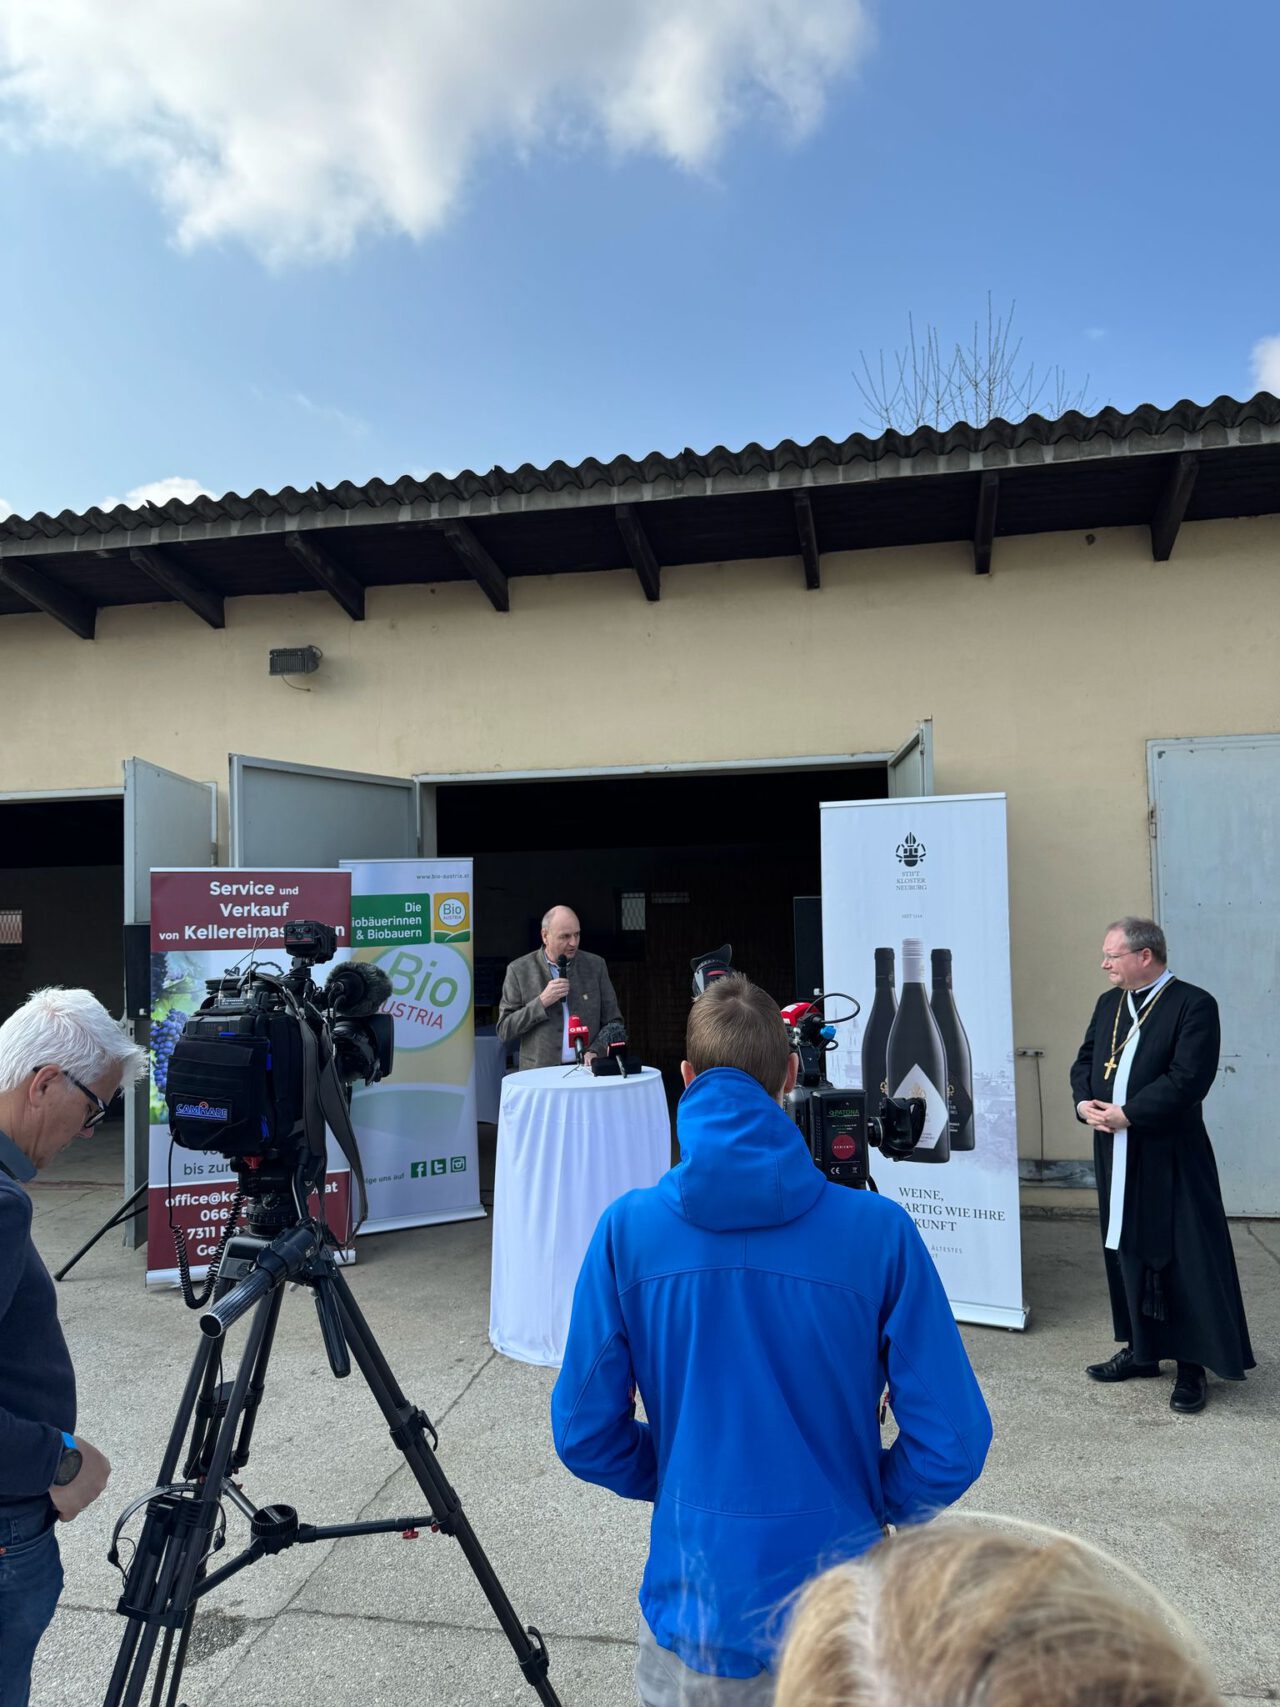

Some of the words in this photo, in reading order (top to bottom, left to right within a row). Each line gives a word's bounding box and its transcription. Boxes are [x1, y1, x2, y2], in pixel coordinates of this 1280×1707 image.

[209, 881, 275, 896] Service
[279, 886, 299, 895] und
[220, 902, 290, 917] Verkauf
[405, 902, 422, 913] Die
[443, 903, 462, 915] Bio
[351, 915, 422, 928] iobäuerinnen
[159, 932, 179, 941] von
[184, 924, 345, 940] Kellereimasn
[356, 930, 364, 940] &
[367, 929, 422, 940] Biobauern
[389, 951, 458, 1008] Bio
[380, 1001, 443, 1030] USTRIA
[183, 1163, 204, 1176] bis
[899, 1187, 944, 1201] WEINE,
[944, 1206, 971, 1218] WIE
[973, 1209, 1006, 1221] IHRE
[914, 1218, 957, 1231] KUNFT
[187, 1227, 216, 1240] 7311
